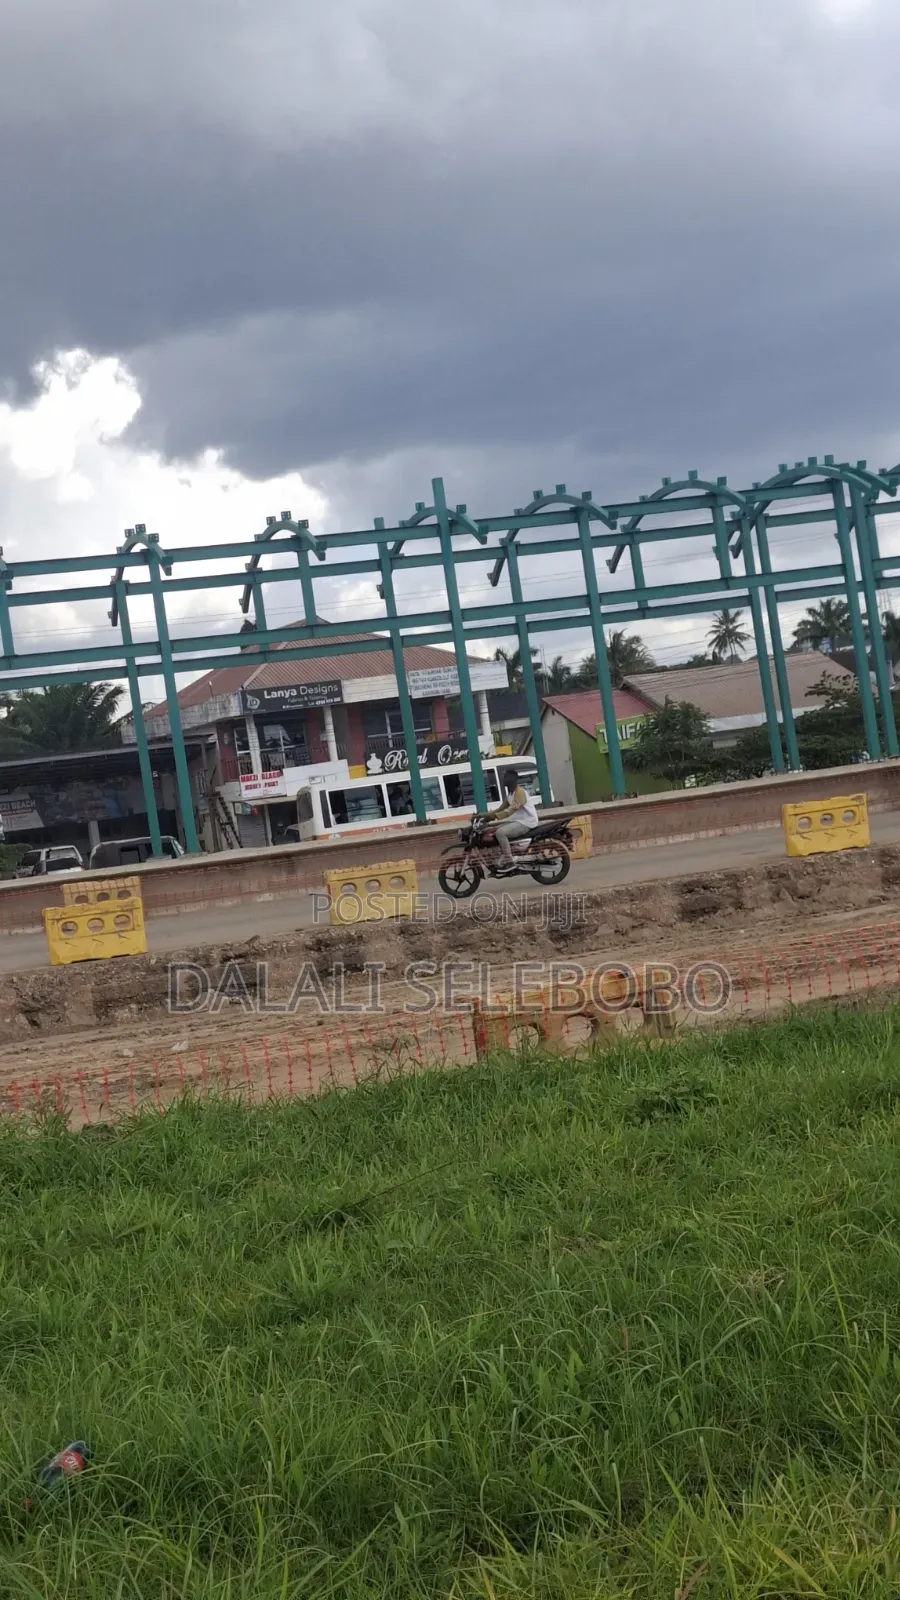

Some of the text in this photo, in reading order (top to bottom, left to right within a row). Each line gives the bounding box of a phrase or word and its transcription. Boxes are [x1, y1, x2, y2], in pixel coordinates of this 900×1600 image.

[264, 684, 339, 699] Lanya Designs
[599, 721, 643, 743] TIF
[11, 800, 36, 810] BEACH
